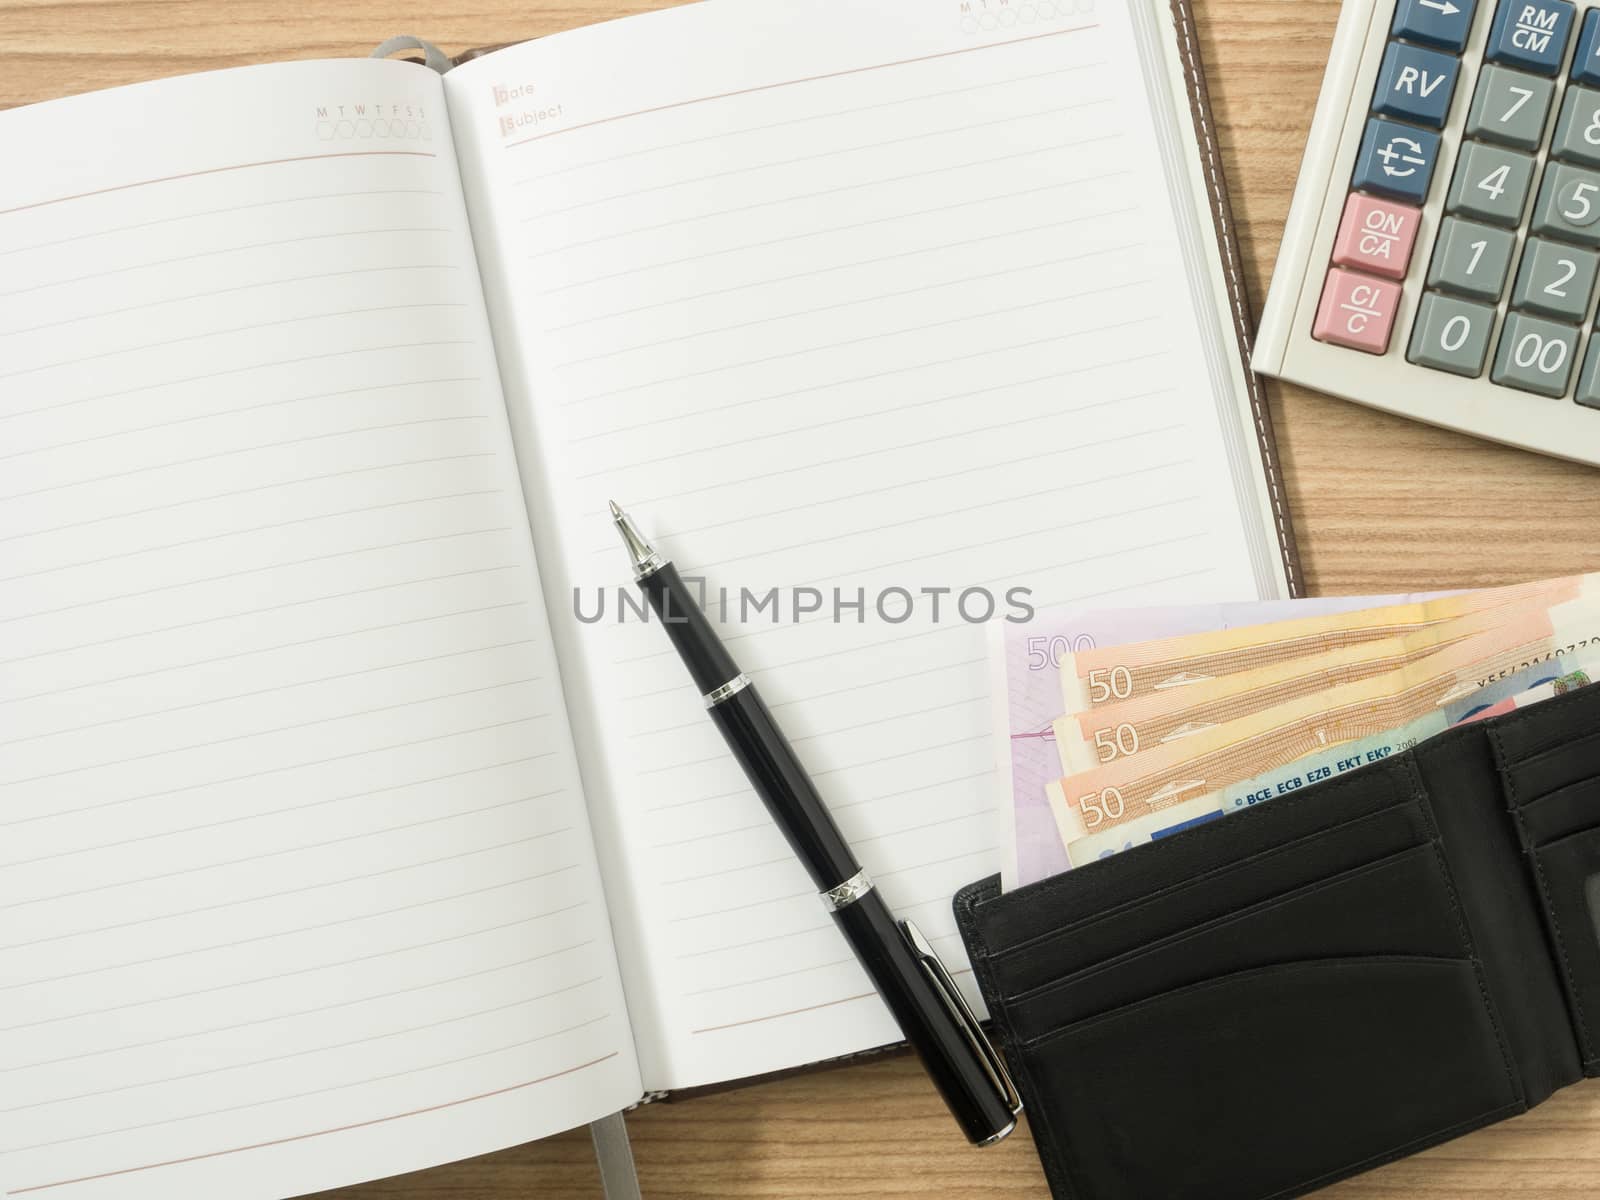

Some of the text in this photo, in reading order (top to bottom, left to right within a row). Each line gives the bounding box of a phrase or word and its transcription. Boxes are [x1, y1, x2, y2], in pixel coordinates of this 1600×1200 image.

[1518, 5, 1560, 31] RM
[1511, 30, 1551, 53] CM
[498, 84, 536, 103] Date
[1395, 65, 1446, 98] RV
[316, 107, 329, 118] M
[338, 105, 347, 117] T
[354, 104, 366, 116] W
[375, 104, 383, 116] T
[506, 103, 564, 131] Subject
[1499, 86, 1534, 123] 7
[1478, 165, 1511, 201] 4
[1563, 182, 1600, 220] 5
[1365, 210, 1404, 235] ON
[1359, 235, 1391, 259] CA
[1465, 240, 1488, 275] 1
[1543, 259, 1577, 298] 2
[1346, 313, 1369, 334] C
[1440, 315, 1471, 352] 0
[1513, 333, 1568, 374] 00
[1088, 665, 1133, 704] 50
[1094, 723, 1140, 763] 50
[1245, 788, 1273, 806] BCE
[1276, 777, 1303, 795] ECB
[1306, 765, 1332, 784] EZB
[1336, 755, 1362, 773] EKT
[1366, 746, 1392, 764] EKP
[1079, 786, 1125, 828] 50
